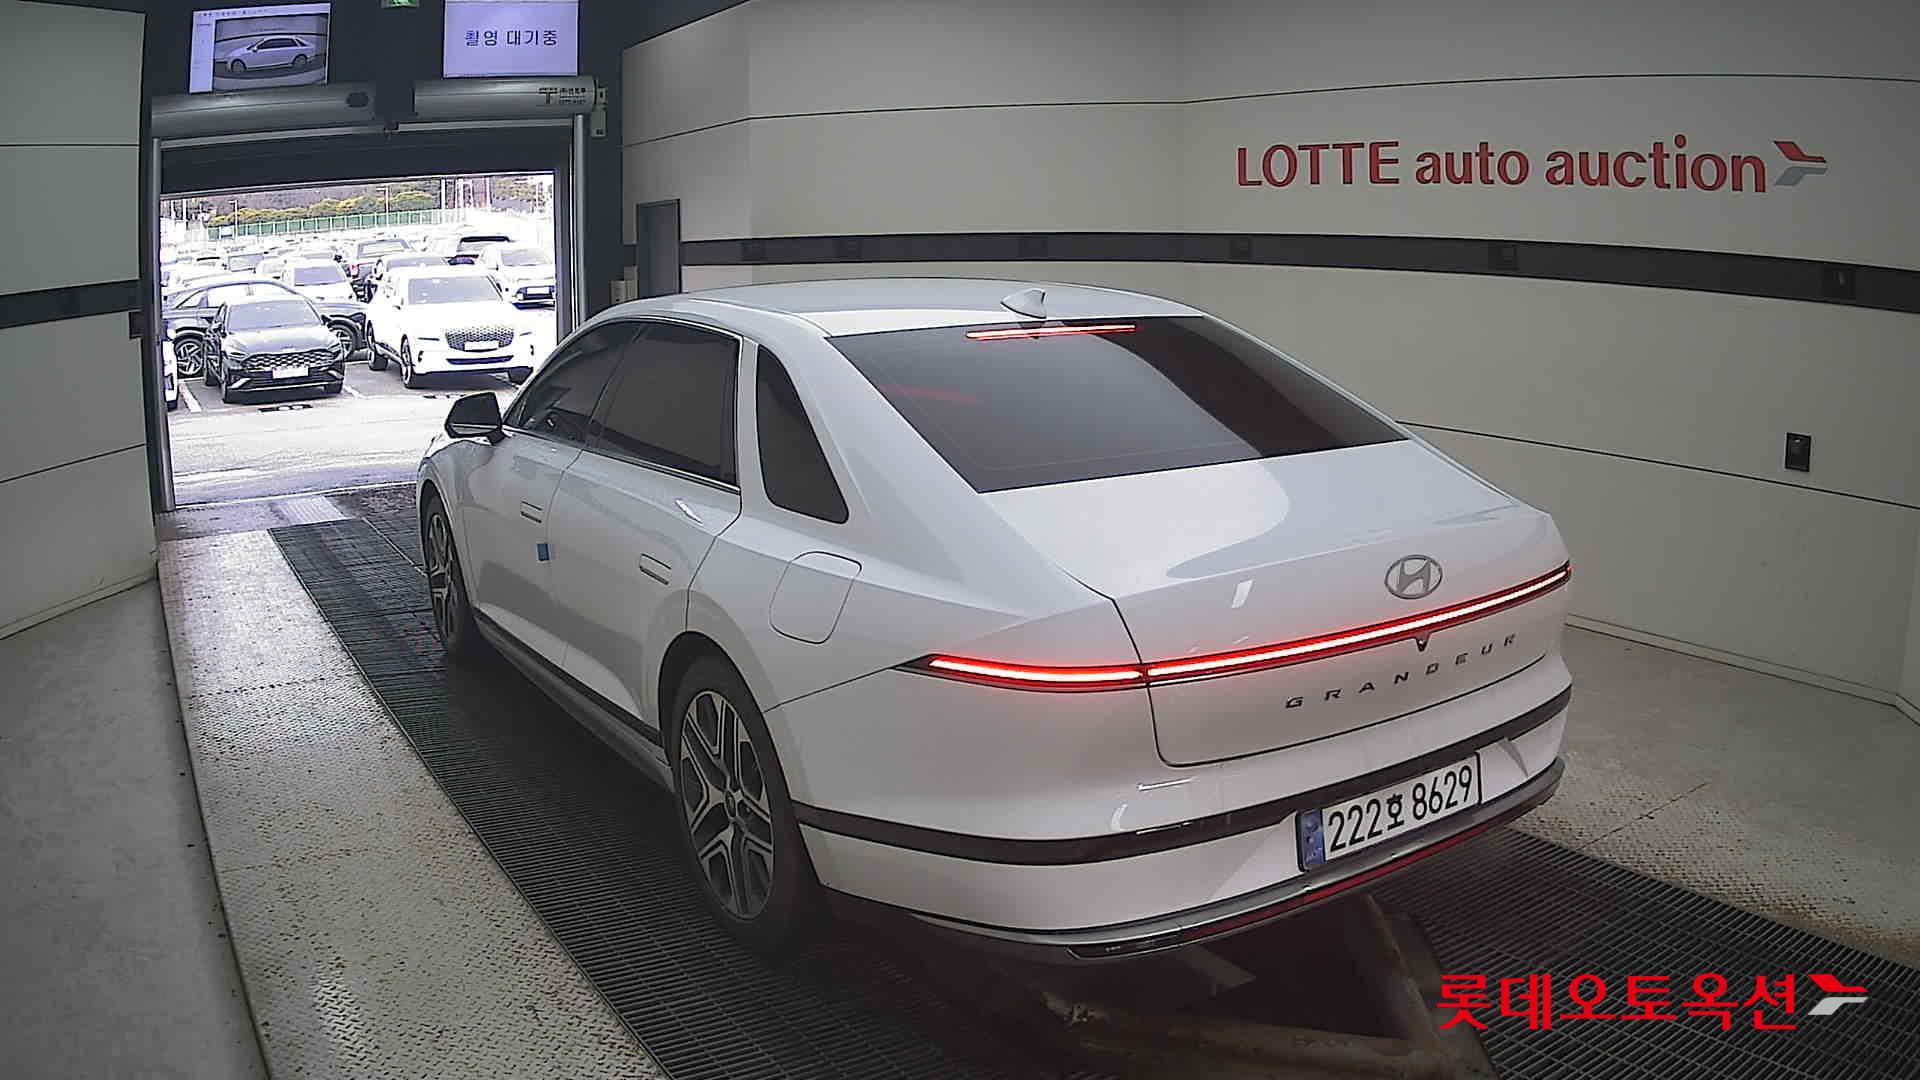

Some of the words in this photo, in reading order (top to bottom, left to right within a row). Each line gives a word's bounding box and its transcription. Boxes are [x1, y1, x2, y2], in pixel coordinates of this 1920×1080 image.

[506, 30, 558, 47] 대기중
[1236, 140, 1400, 188] LOTTE
[1415, 141, 1529, 187] auto
[1544, 134, 1767, 193] auction
[1284, 633, 1516, 709] GRANDEUR
[1328, 793, 1405, 852] 222호
[1412, 765, 1473, 821] 8629
